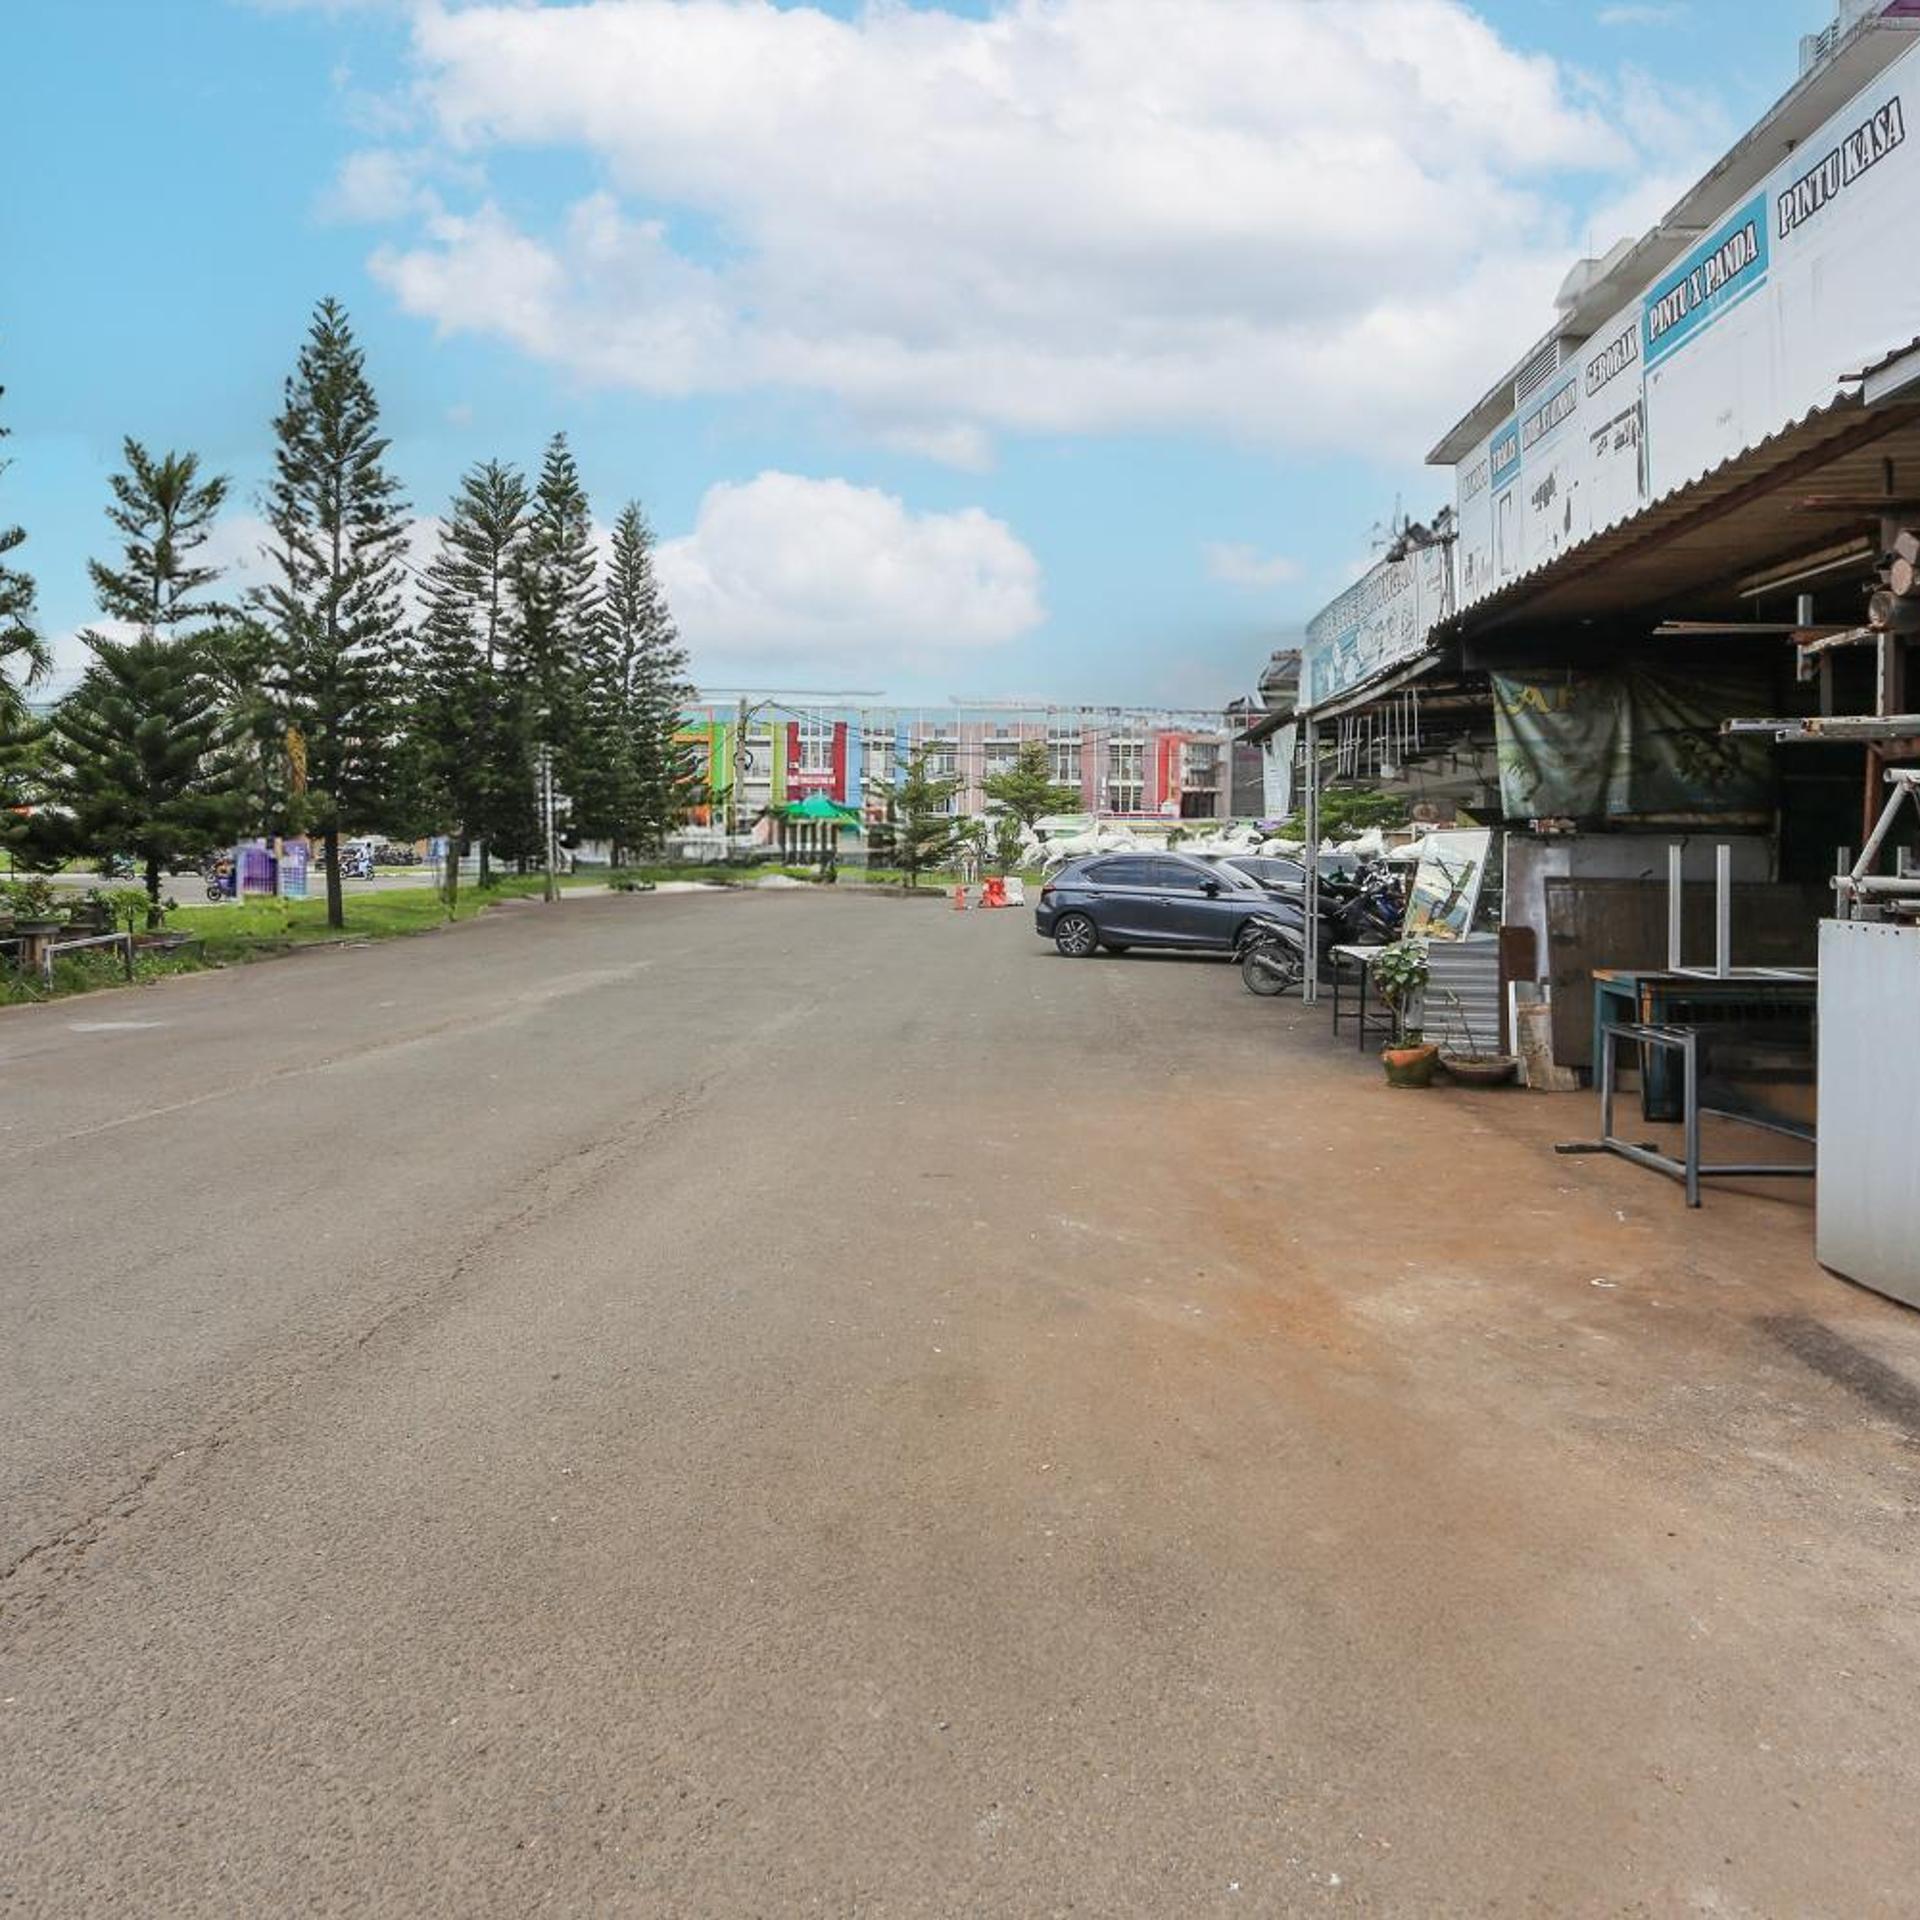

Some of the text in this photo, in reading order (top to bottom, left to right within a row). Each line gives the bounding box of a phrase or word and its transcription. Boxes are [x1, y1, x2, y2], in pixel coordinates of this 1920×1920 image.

[1778, 96, 1905, 239] PINTU KASA
[1649, 220, 1759, 344] PINTU X PANDA
